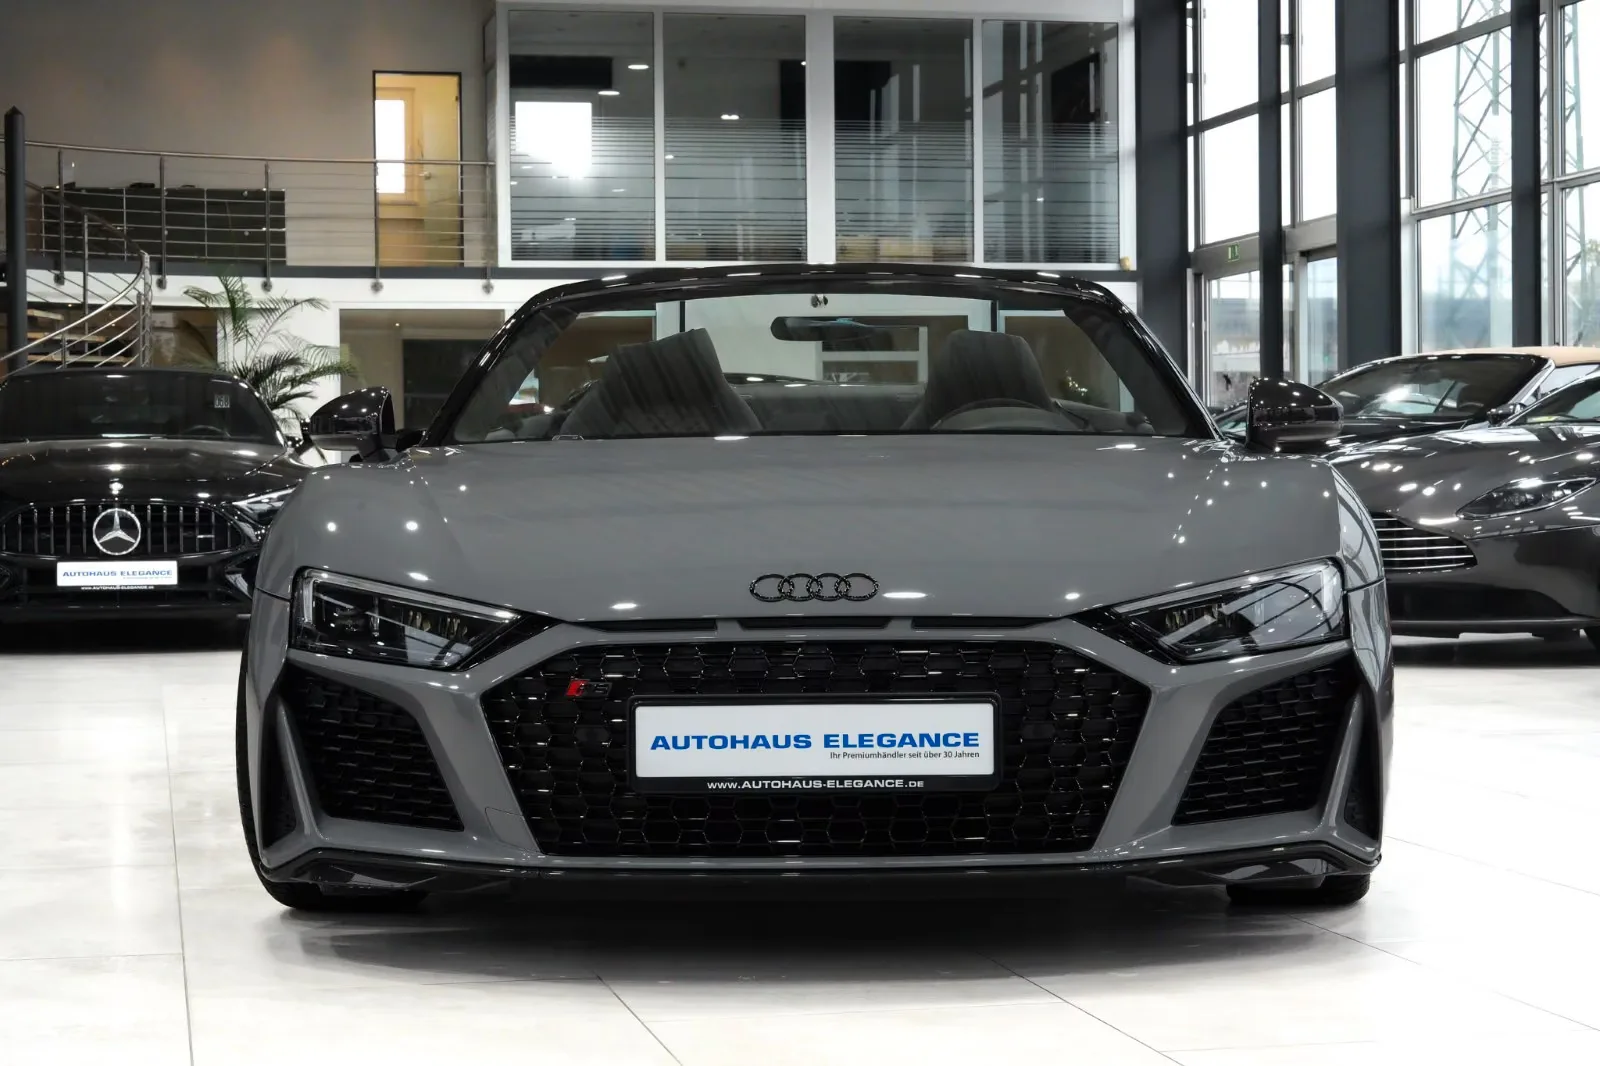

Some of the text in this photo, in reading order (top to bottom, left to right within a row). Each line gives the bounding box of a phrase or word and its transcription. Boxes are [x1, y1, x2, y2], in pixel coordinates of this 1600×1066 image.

[650, 732, 980, 751] AUTOHAUS ELEGANCE
[829, 750, 980, 759] Ihr Premiumhändler seit über 30 Jahren
